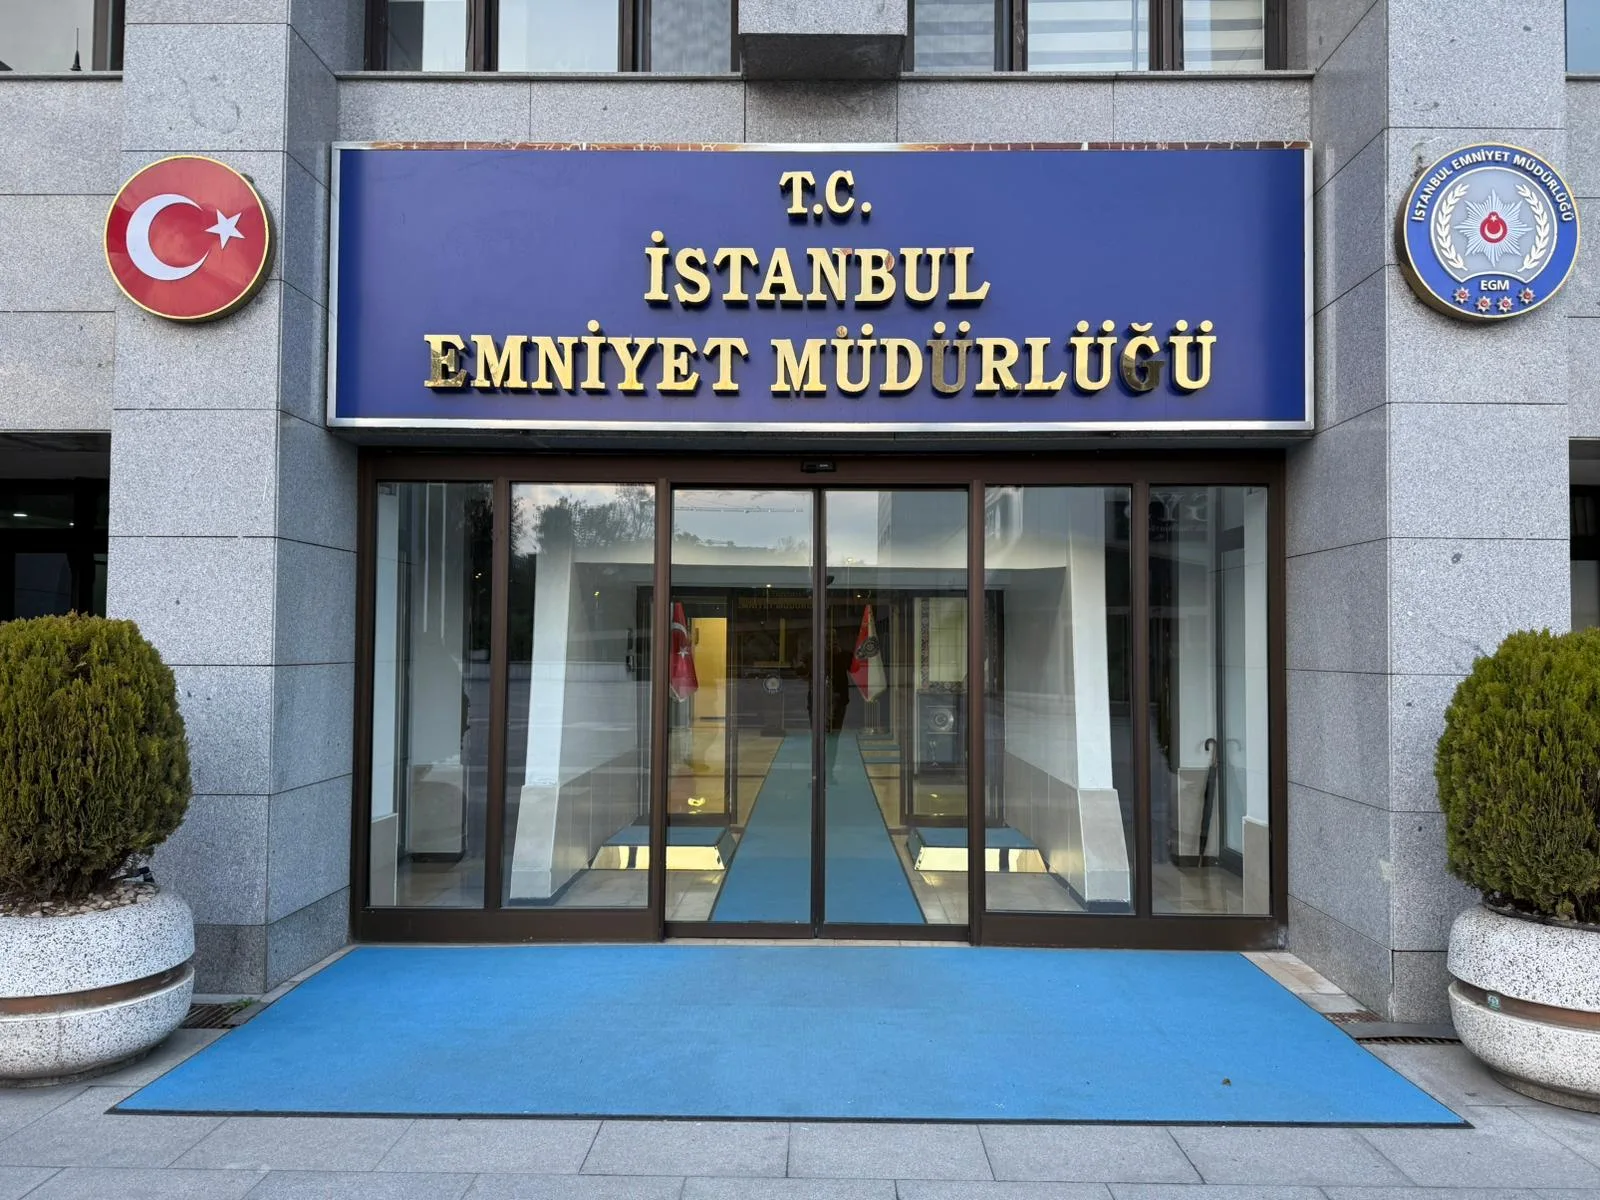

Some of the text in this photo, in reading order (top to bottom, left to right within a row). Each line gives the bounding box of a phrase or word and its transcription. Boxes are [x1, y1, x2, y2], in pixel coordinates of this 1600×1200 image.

[779, 170, 872, 215] T.C.
[1452, 149, 1510, 170] EMNİYET
[1513, 154, 1574, 221] MÜDÜRLÜĞÜ
[644, 230, 991, 303] İSTANBUL
[1480, 280, 1510, 291] EGM
[423, 319, 1218, 393] EMNİYET MÜDÜRLÜĞÜ
